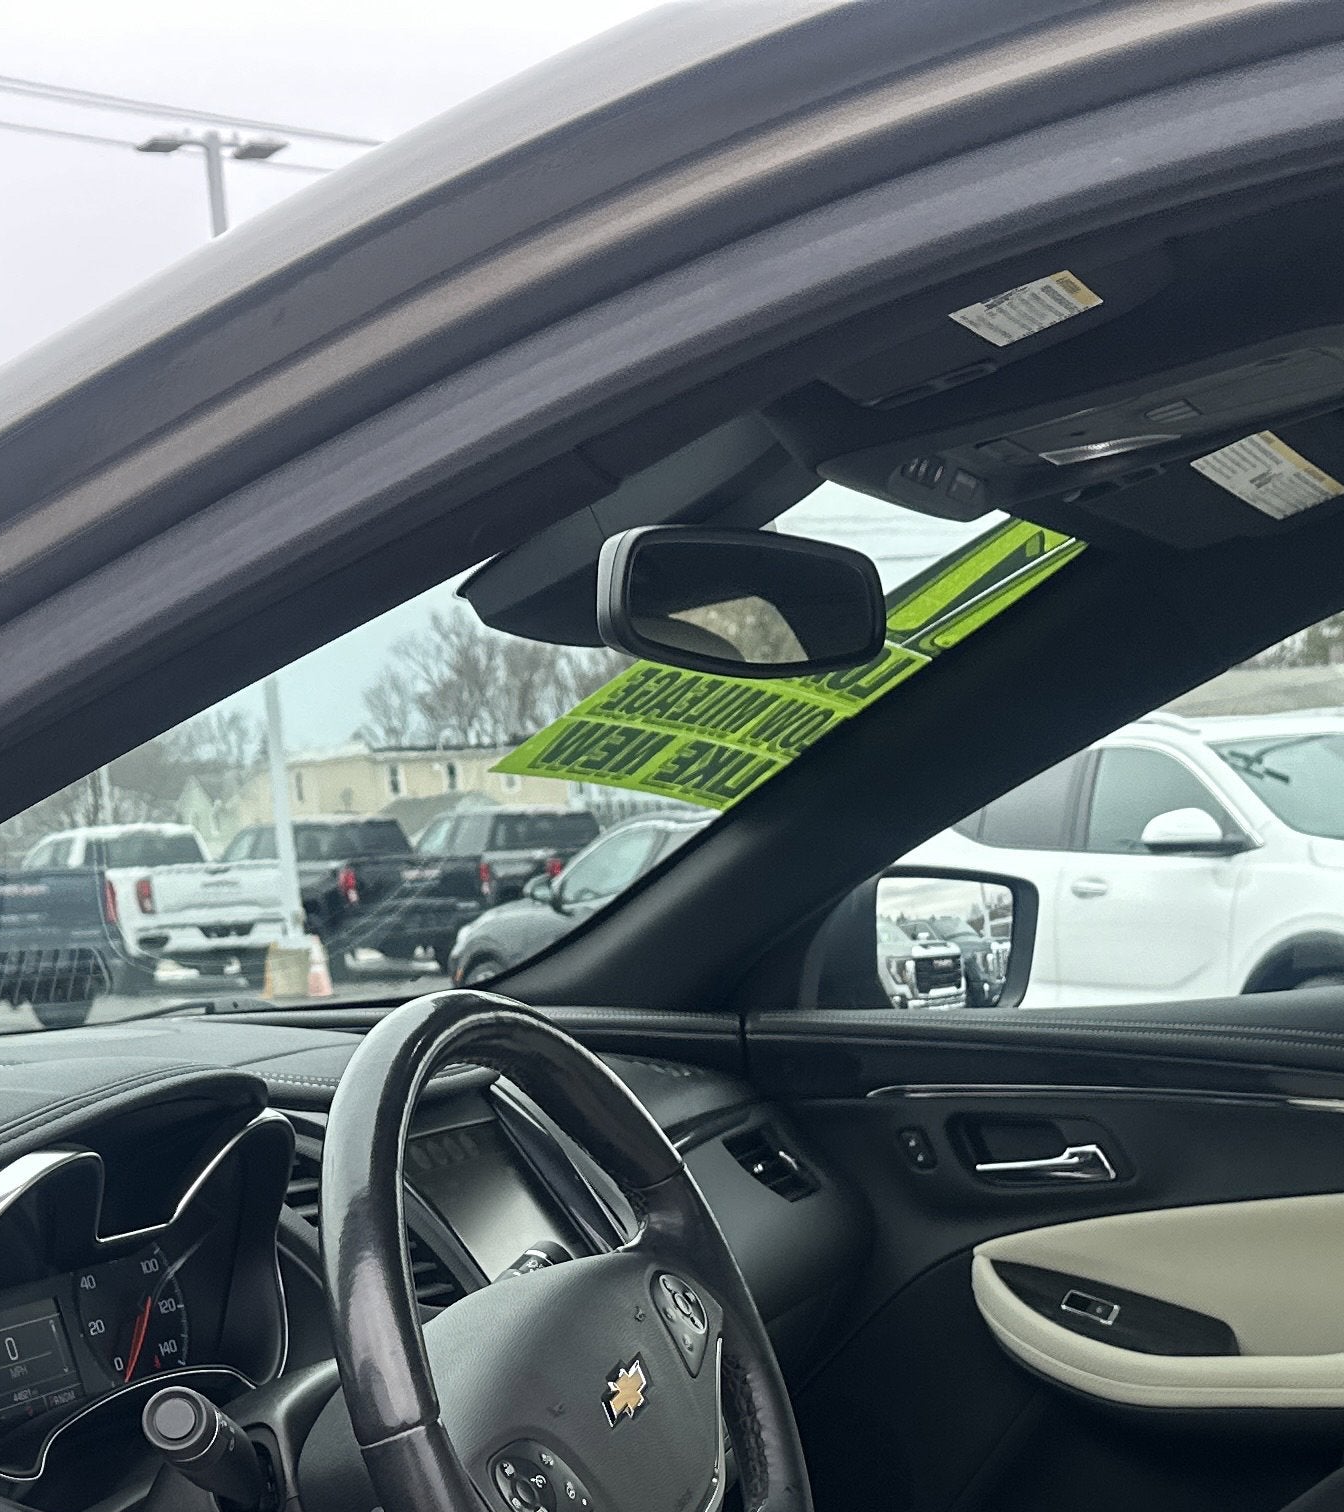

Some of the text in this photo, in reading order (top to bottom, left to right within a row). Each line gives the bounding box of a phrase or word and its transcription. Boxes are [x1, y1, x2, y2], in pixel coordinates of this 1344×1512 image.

[140, 1258, 159, 1274] 100
[80, 1275, 96, 1290] 40
[158, 1298, 176, 1314] 120
[88, 1319, 105, 1336] 20
[5, 1337, 18, 1360] 0
[158, 1339, 177, 1356] 140
[113, 1357, 124, 1371] 0
